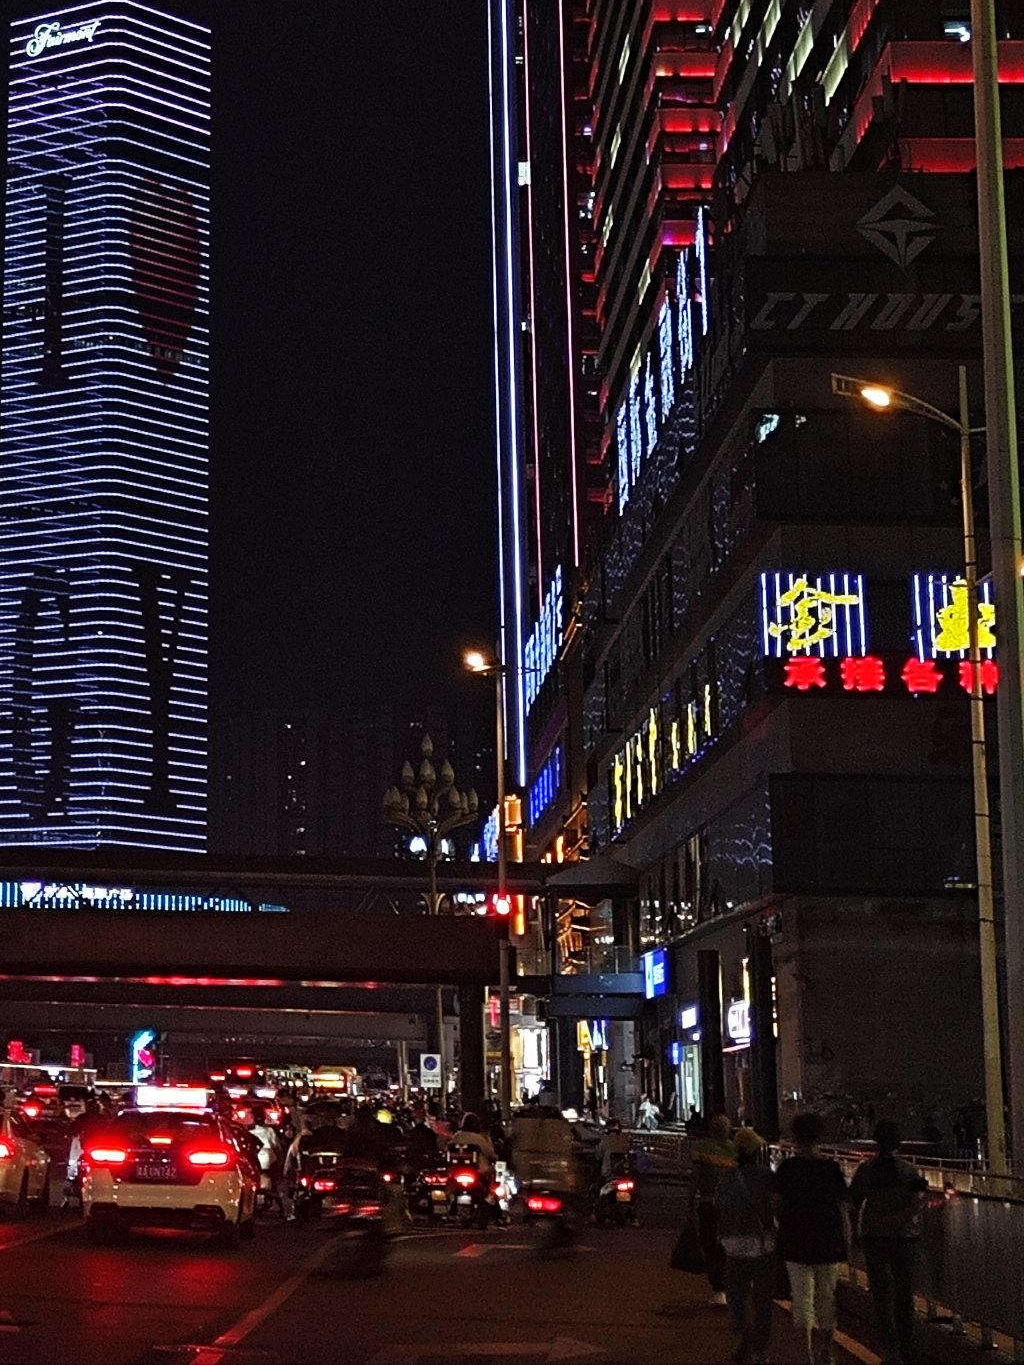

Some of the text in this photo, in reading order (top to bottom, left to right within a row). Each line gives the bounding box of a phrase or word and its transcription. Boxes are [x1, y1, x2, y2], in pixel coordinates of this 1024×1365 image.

[25, 20, 102, 58] Fairmont
[749, 291, 1024, 331] CT HOUS
